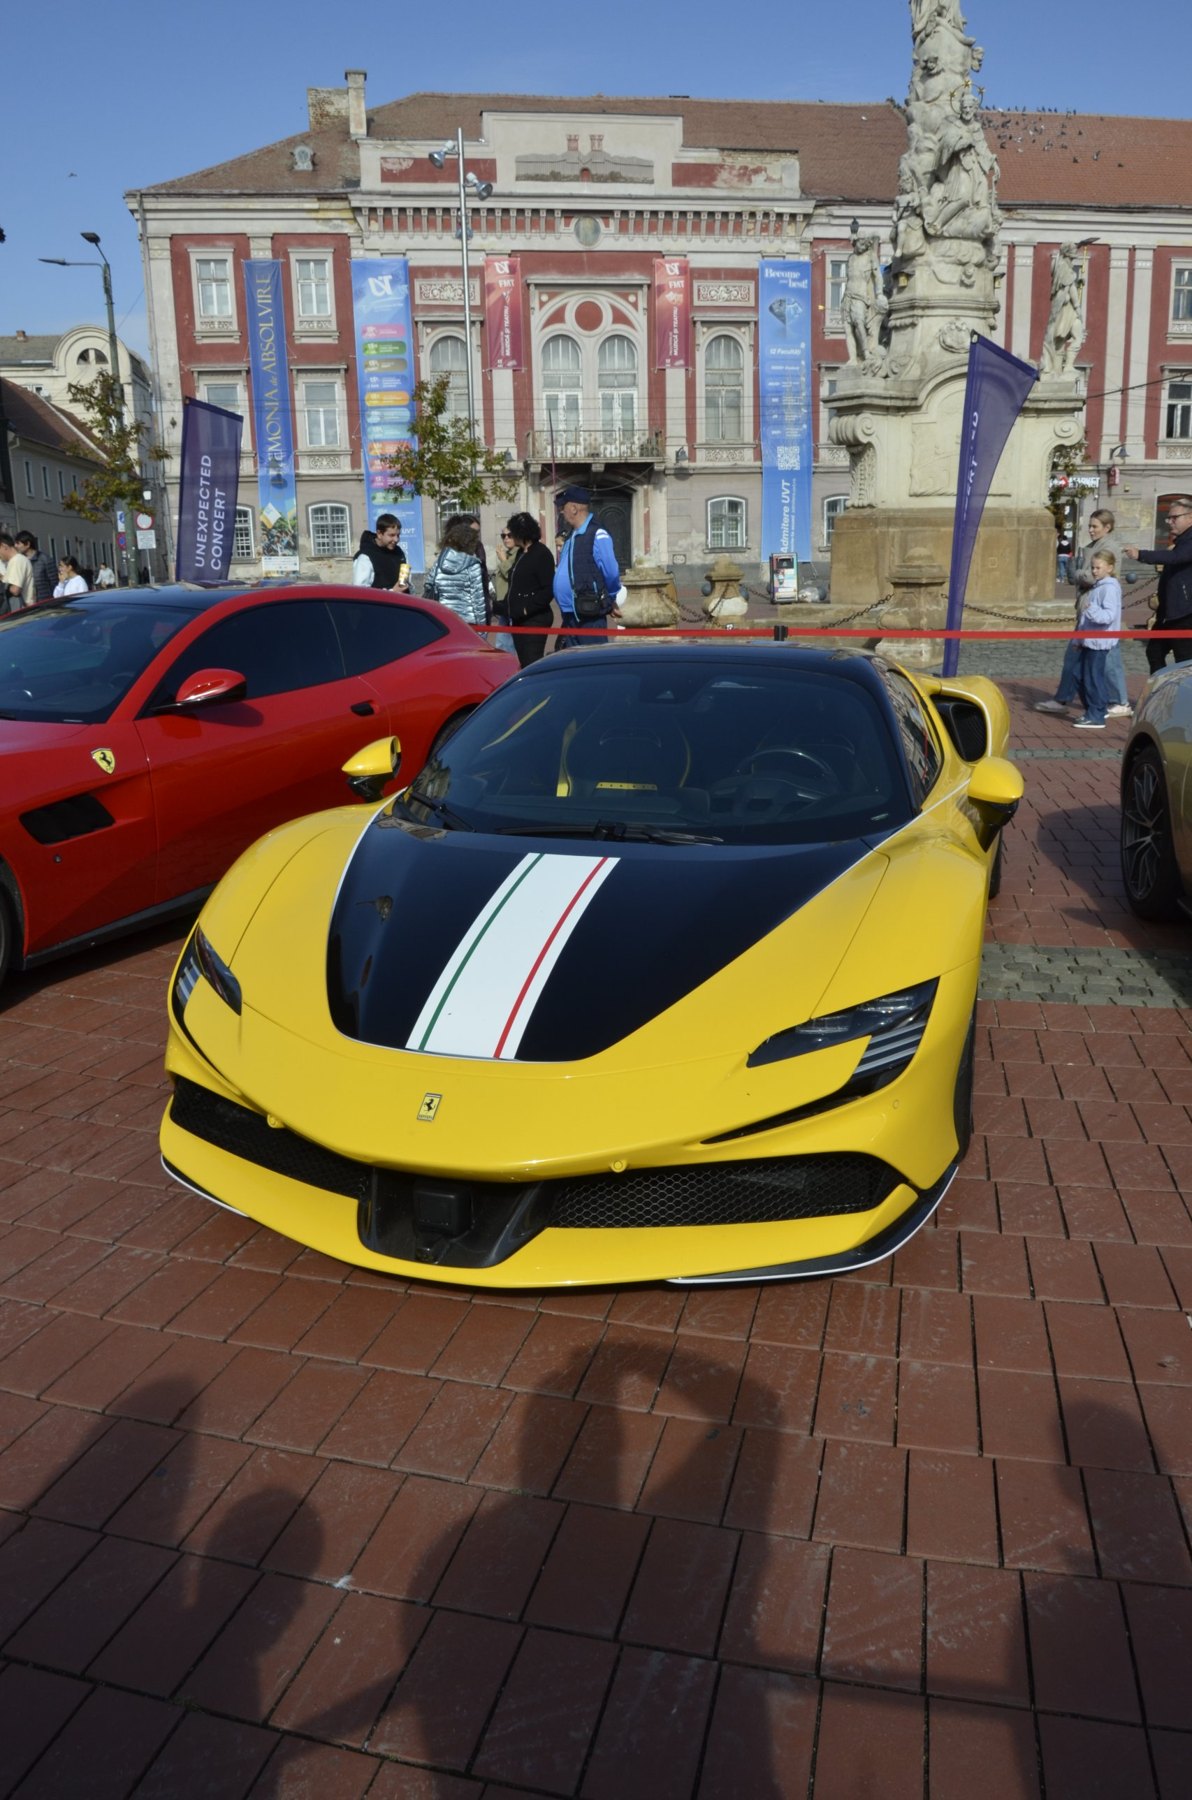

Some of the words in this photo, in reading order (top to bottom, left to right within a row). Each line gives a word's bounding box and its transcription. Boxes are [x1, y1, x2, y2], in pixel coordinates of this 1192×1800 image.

[764, 268, 801, 278] Become
[255, 273, 276, 375] ABSOLVIRE
[195, 455, 213, 568] UNEXPECTED
[780, 479, 791, 504] UVT
[210, 488, 227, 571] CONCERT
[779, 506, 790, 554] Admitere
